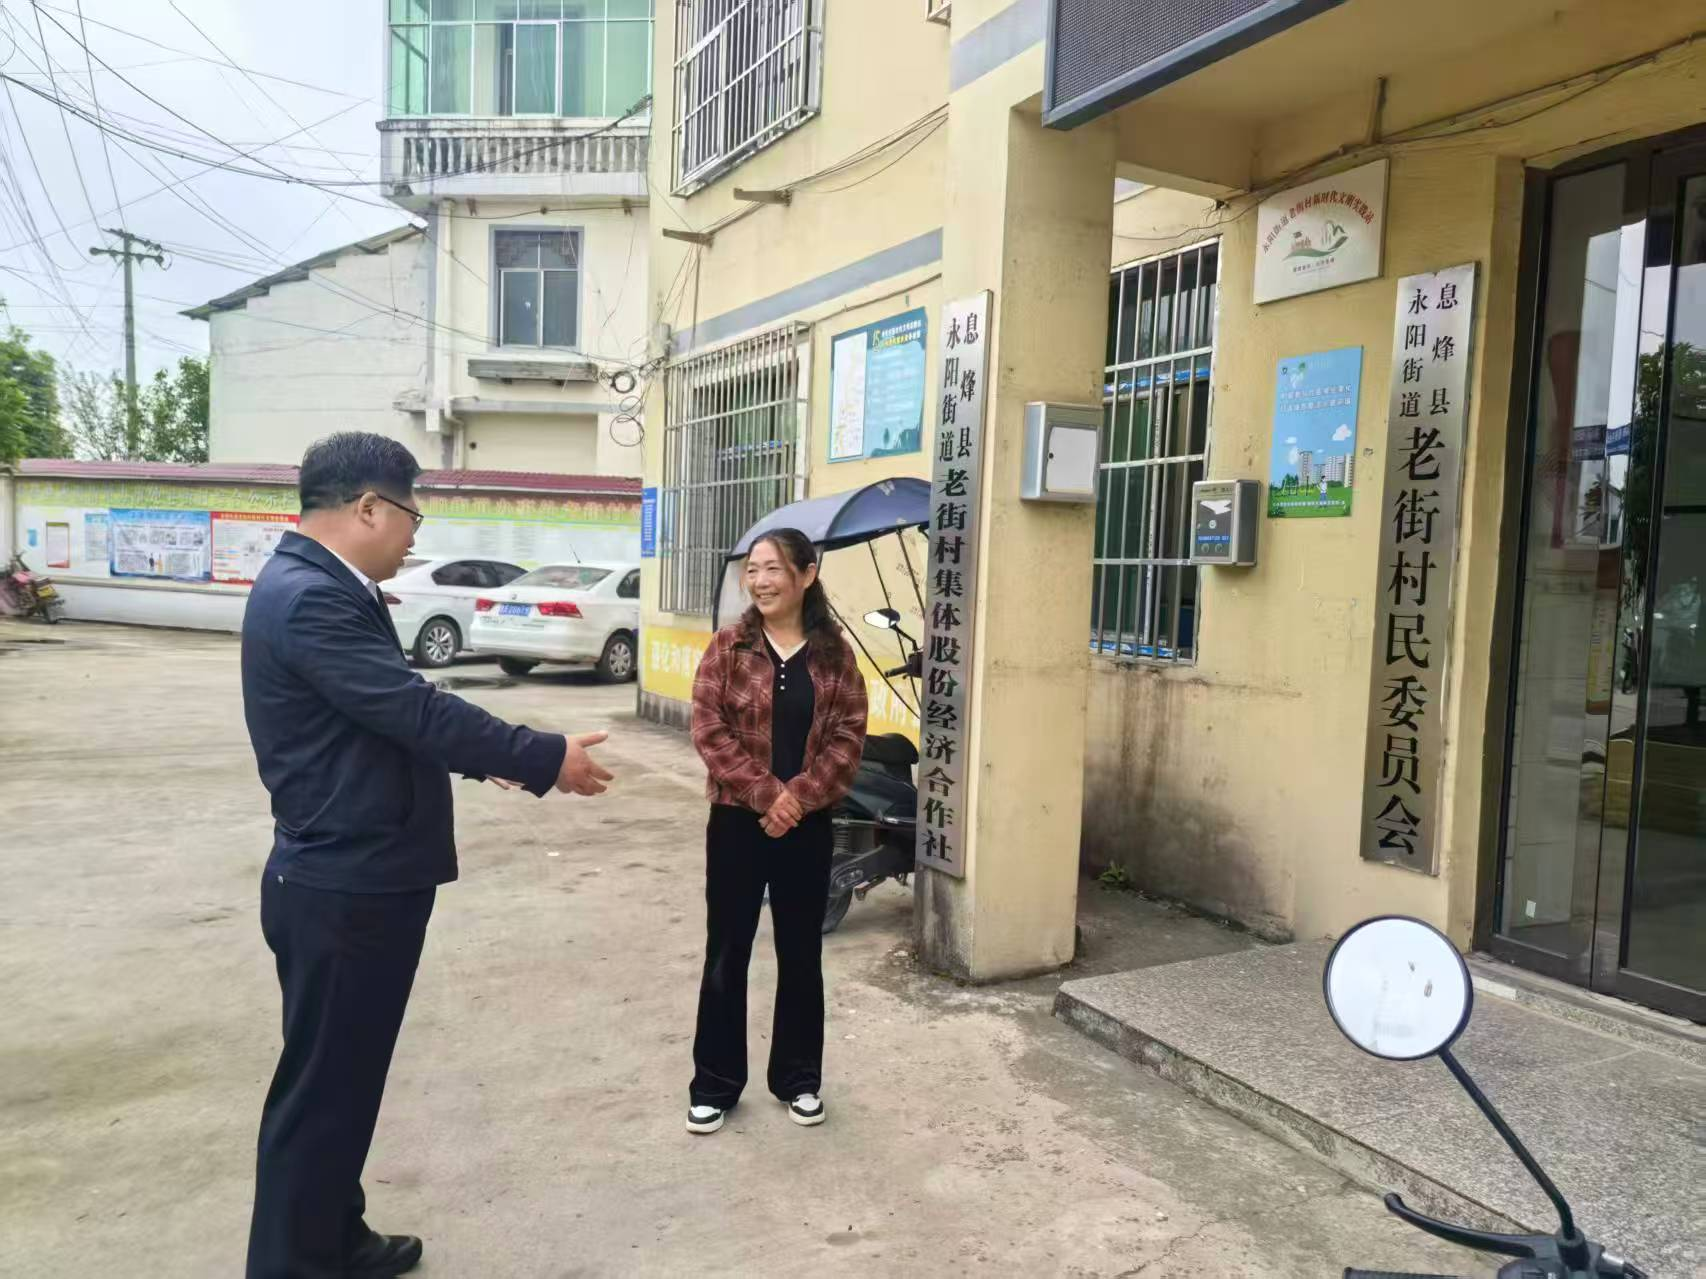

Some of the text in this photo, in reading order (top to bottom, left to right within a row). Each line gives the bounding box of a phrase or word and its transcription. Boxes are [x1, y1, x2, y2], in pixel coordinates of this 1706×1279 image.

[939, 318, 961, 463] 永阳街道
[956, 312, 979, 459] 息烽县
[1399, 288, 1429, 418] 永阳街道
[1427, 283, 1458, 416] 息烽县
[922, 467, 970, 864] 老街村集体股份经济合作社
[1374, 427, 1446, 855] 老街村民委员会
